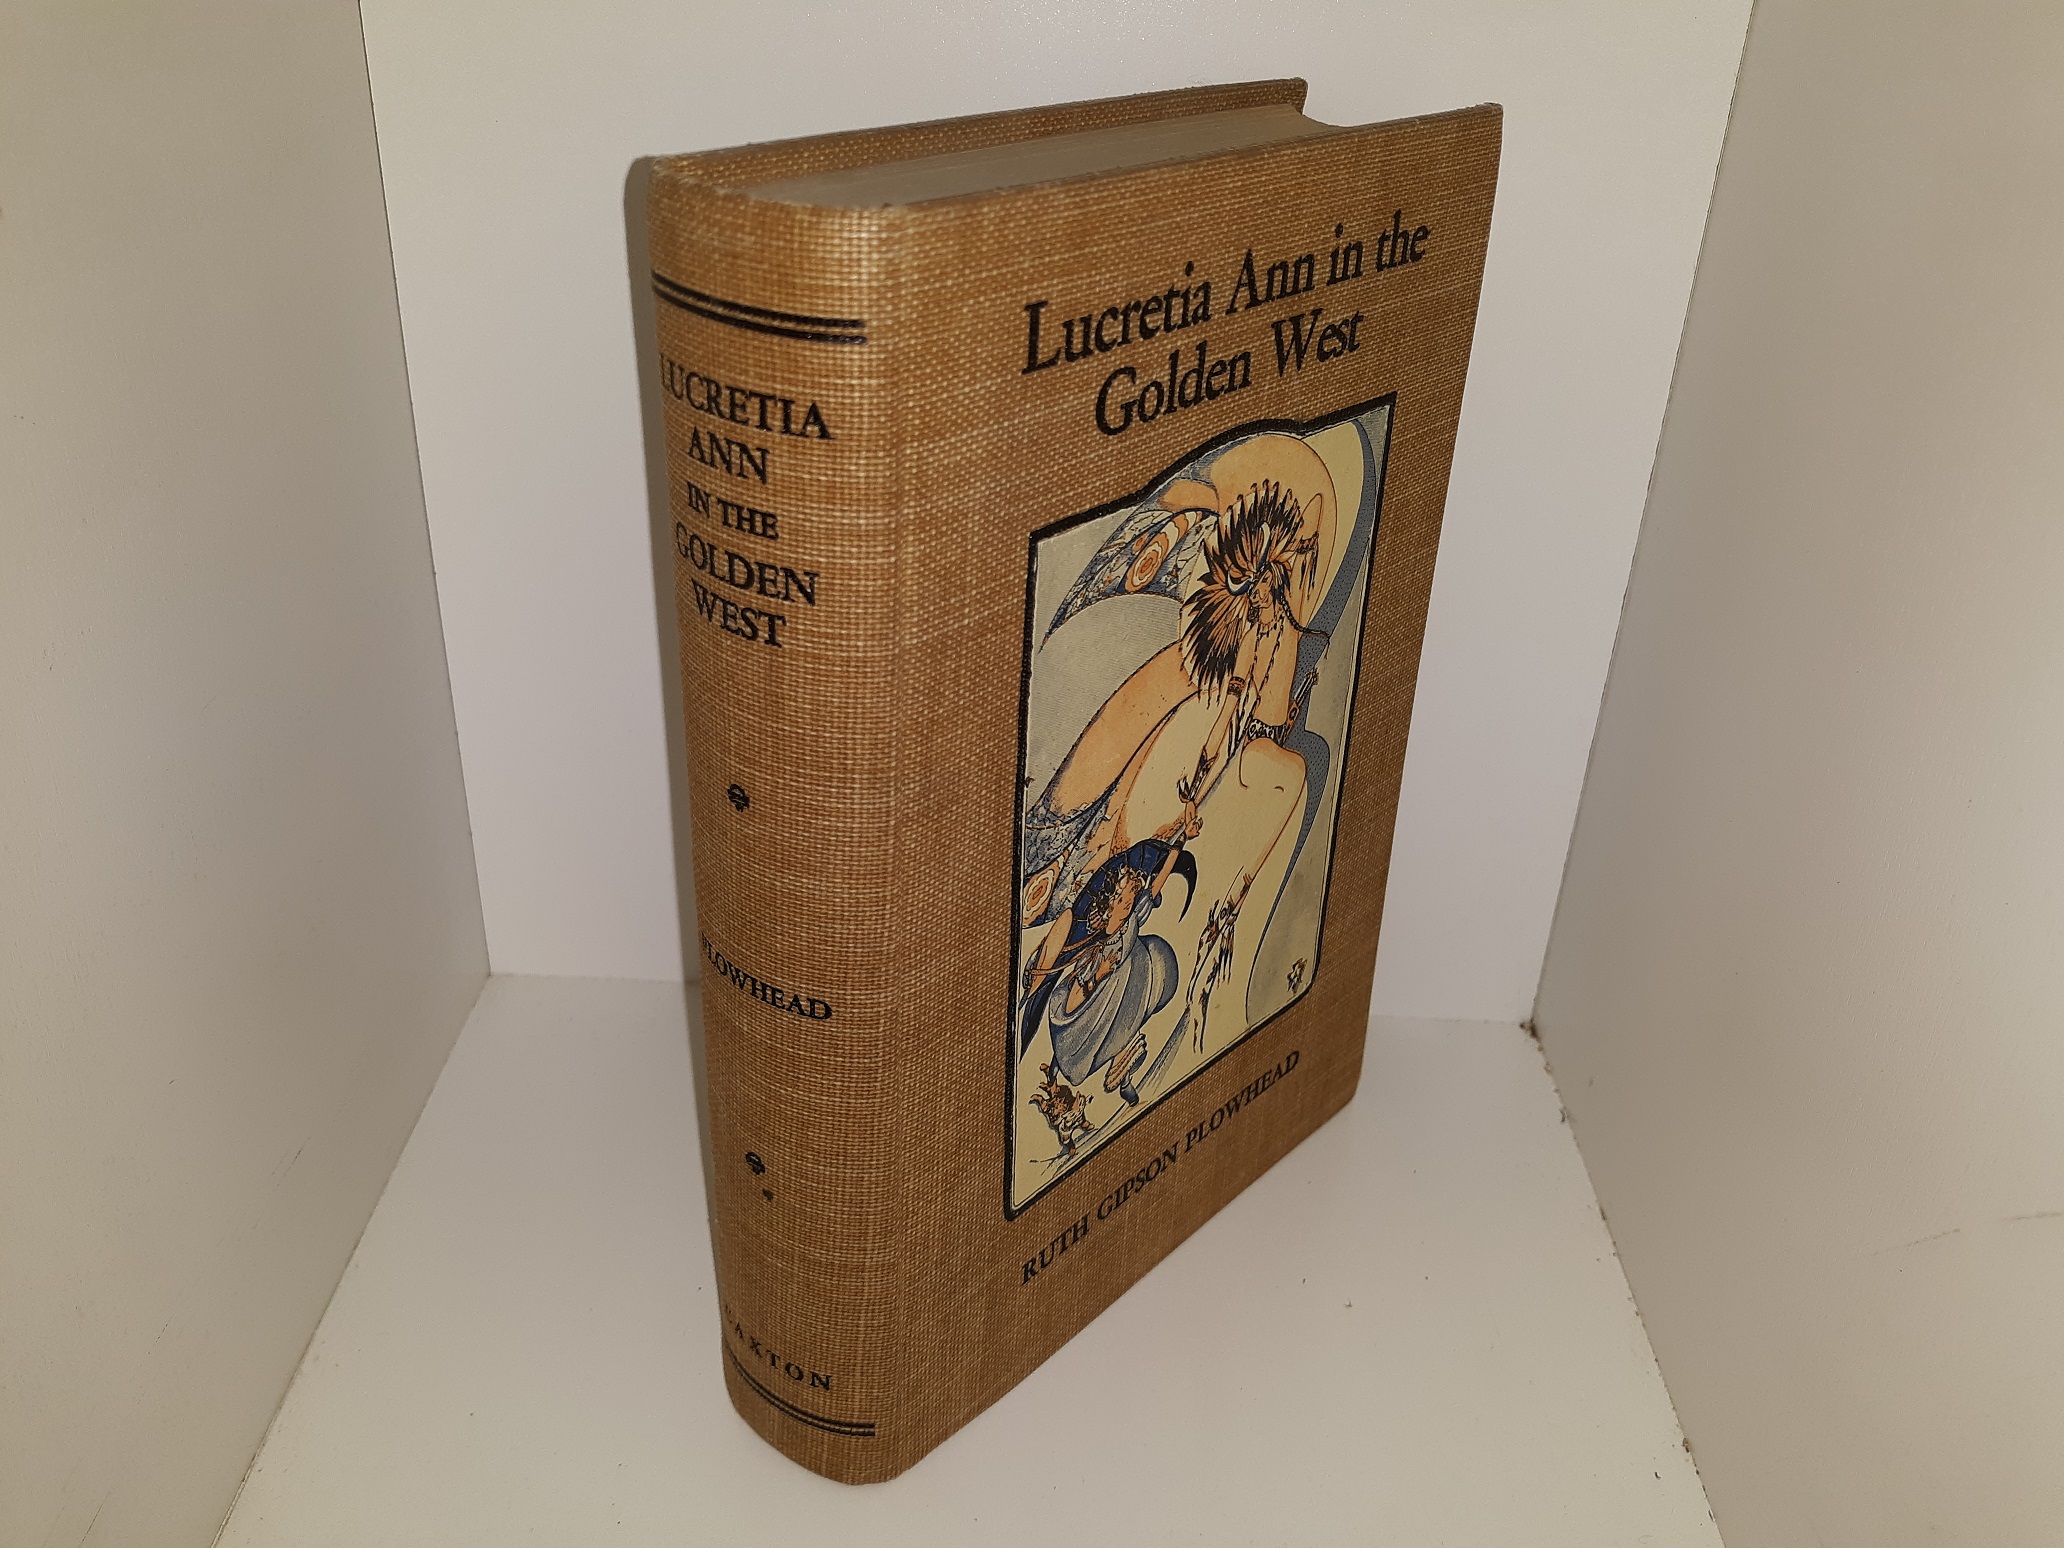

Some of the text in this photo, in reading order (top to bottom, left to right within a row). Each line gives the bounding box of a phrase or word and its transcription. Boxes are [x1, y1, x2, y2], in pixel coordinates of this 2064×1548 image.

[1021, 209, 1431, 375] Lucretia Ann in the
[1095, 308, 1365, 436] Golden West
[688, 426, 769, 485] ANN
[687, 482, 779, 540] IN THE
[676, 521, 820, 607] GOLDEN
[691, 577, 787, 648] WEST
[1021, 1050, 1300, 1285] RUTH GIPSON PLOWHEAD
